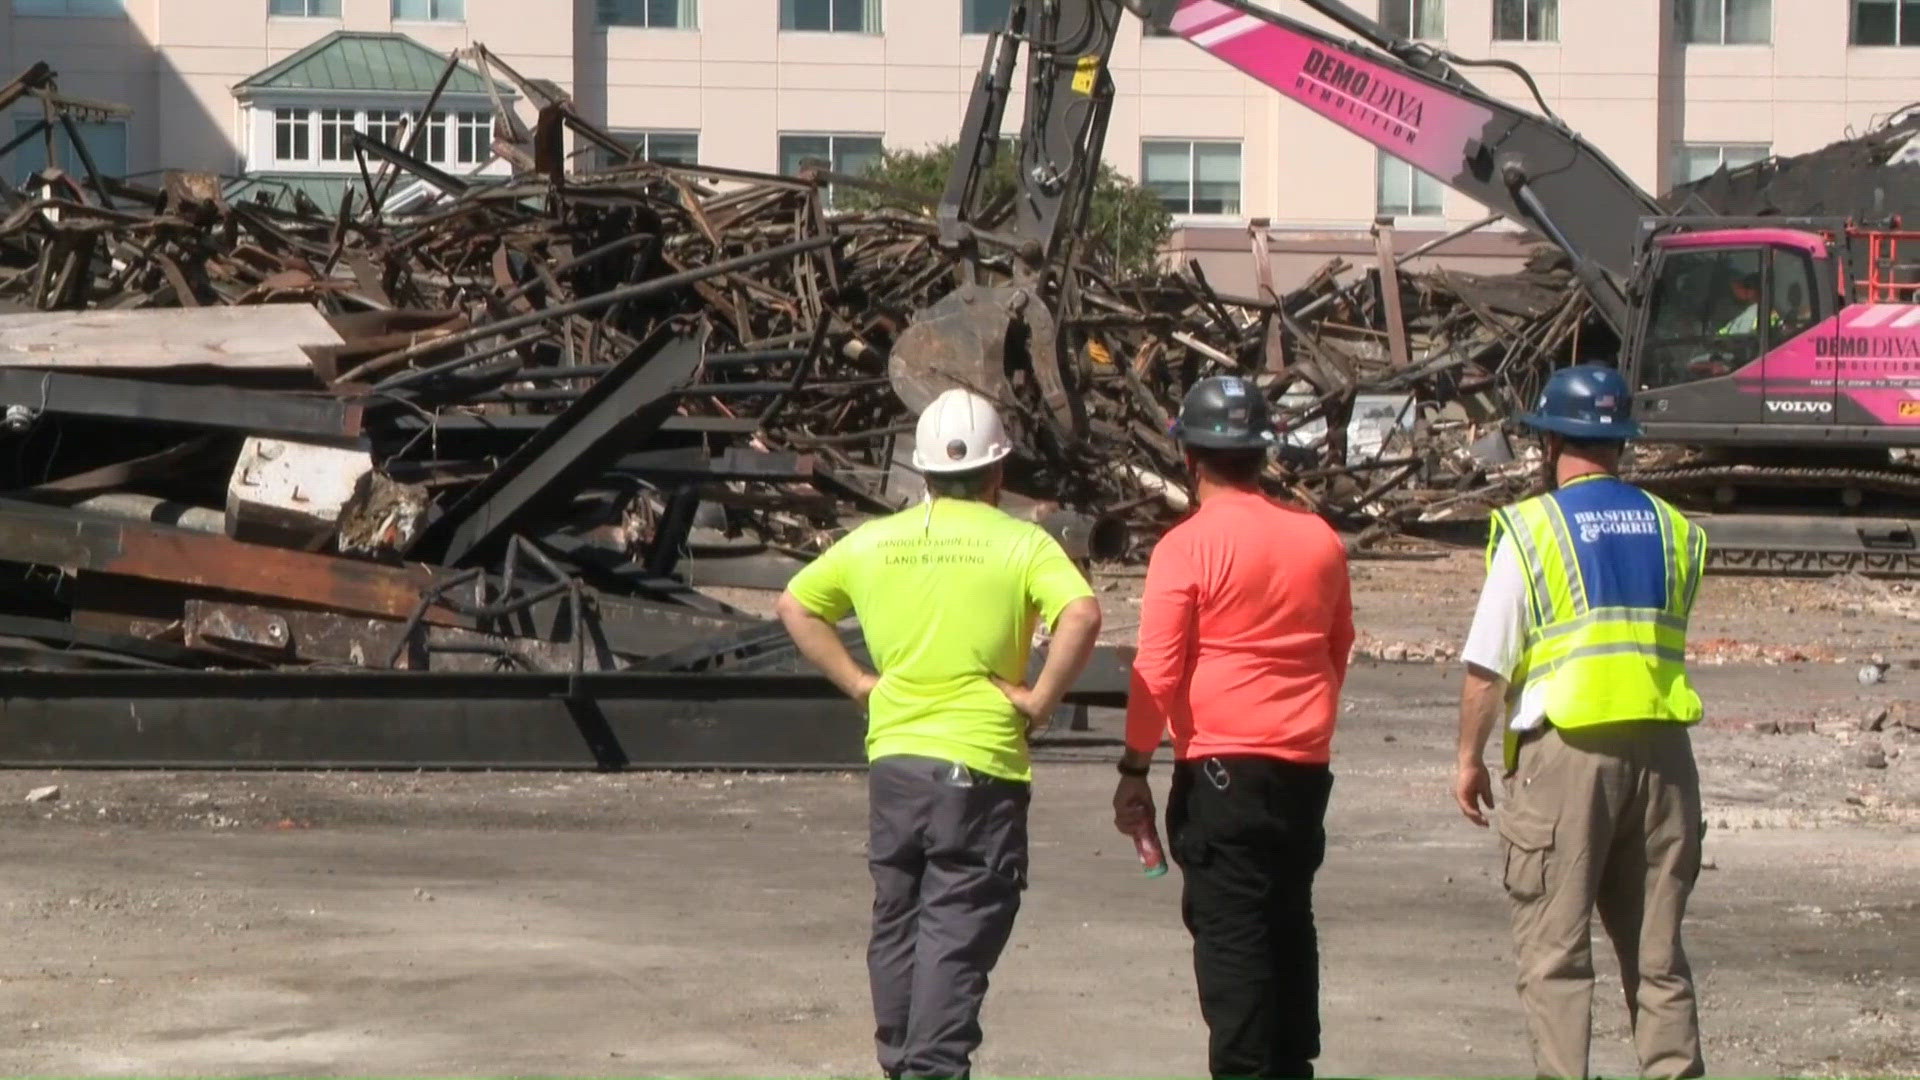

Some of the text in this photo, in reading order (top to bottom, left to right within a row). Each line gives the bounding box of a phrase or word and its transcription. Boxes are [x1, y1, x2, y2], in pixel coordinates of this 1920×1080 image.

[1303, 48, 1423, 128] DEMO DIVA
[1295, 76, 1417, 144] DEMOLITION
[1872, 336, 1920, 357] DIVA
[1766, 400, 1832, 412] VOLVO
[1574, 509, 1656, 524] BRASFIELD
[885, 554, 985, 565] LAND SURVEYING
